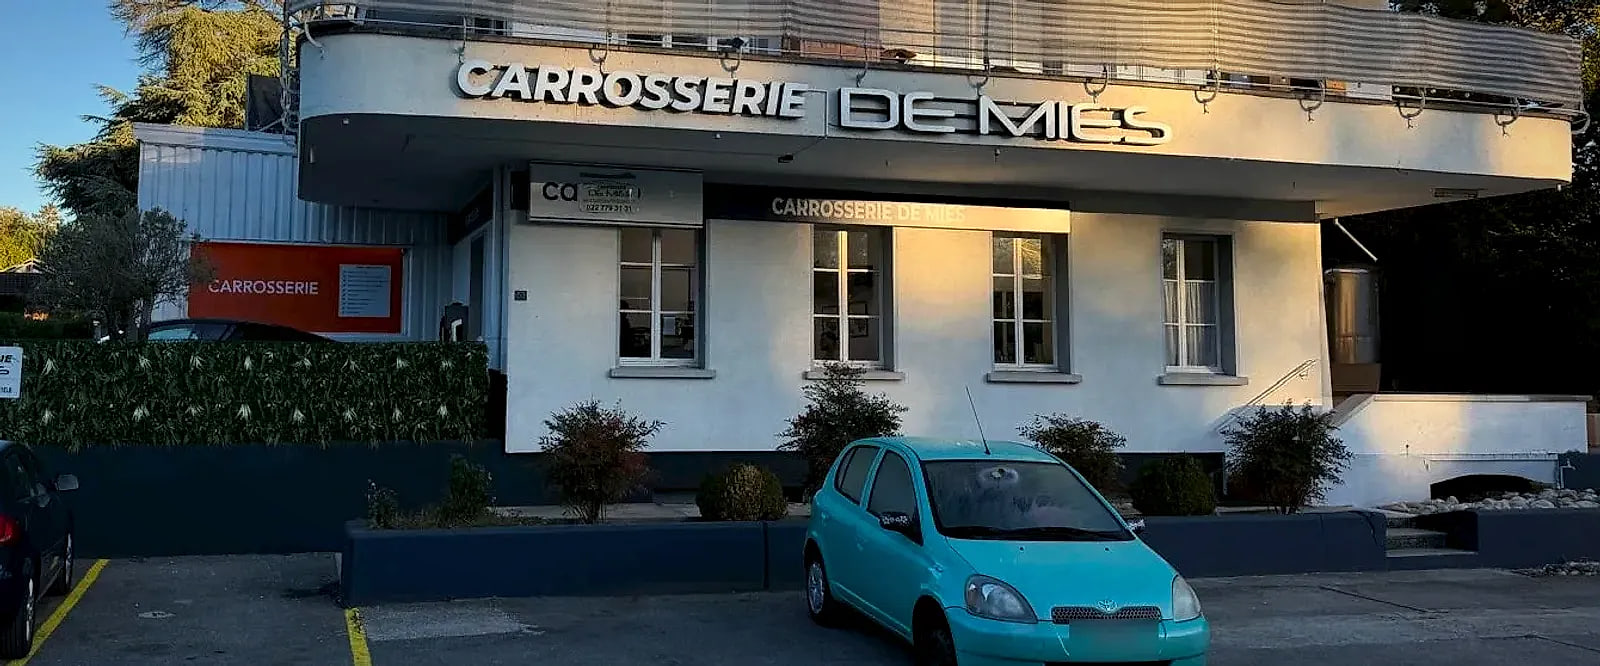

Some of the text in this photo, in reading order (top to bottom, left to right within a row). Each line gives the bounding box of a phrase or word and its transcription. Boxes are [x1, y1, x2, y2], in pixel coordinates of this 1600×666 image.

[457, 58, 1174, 145] CARROSSERIE DE MIES
[772, 197, 966, 224] CARROSSERIE DE MIES
[208, 279, 319, 295] CARROSSERIE
